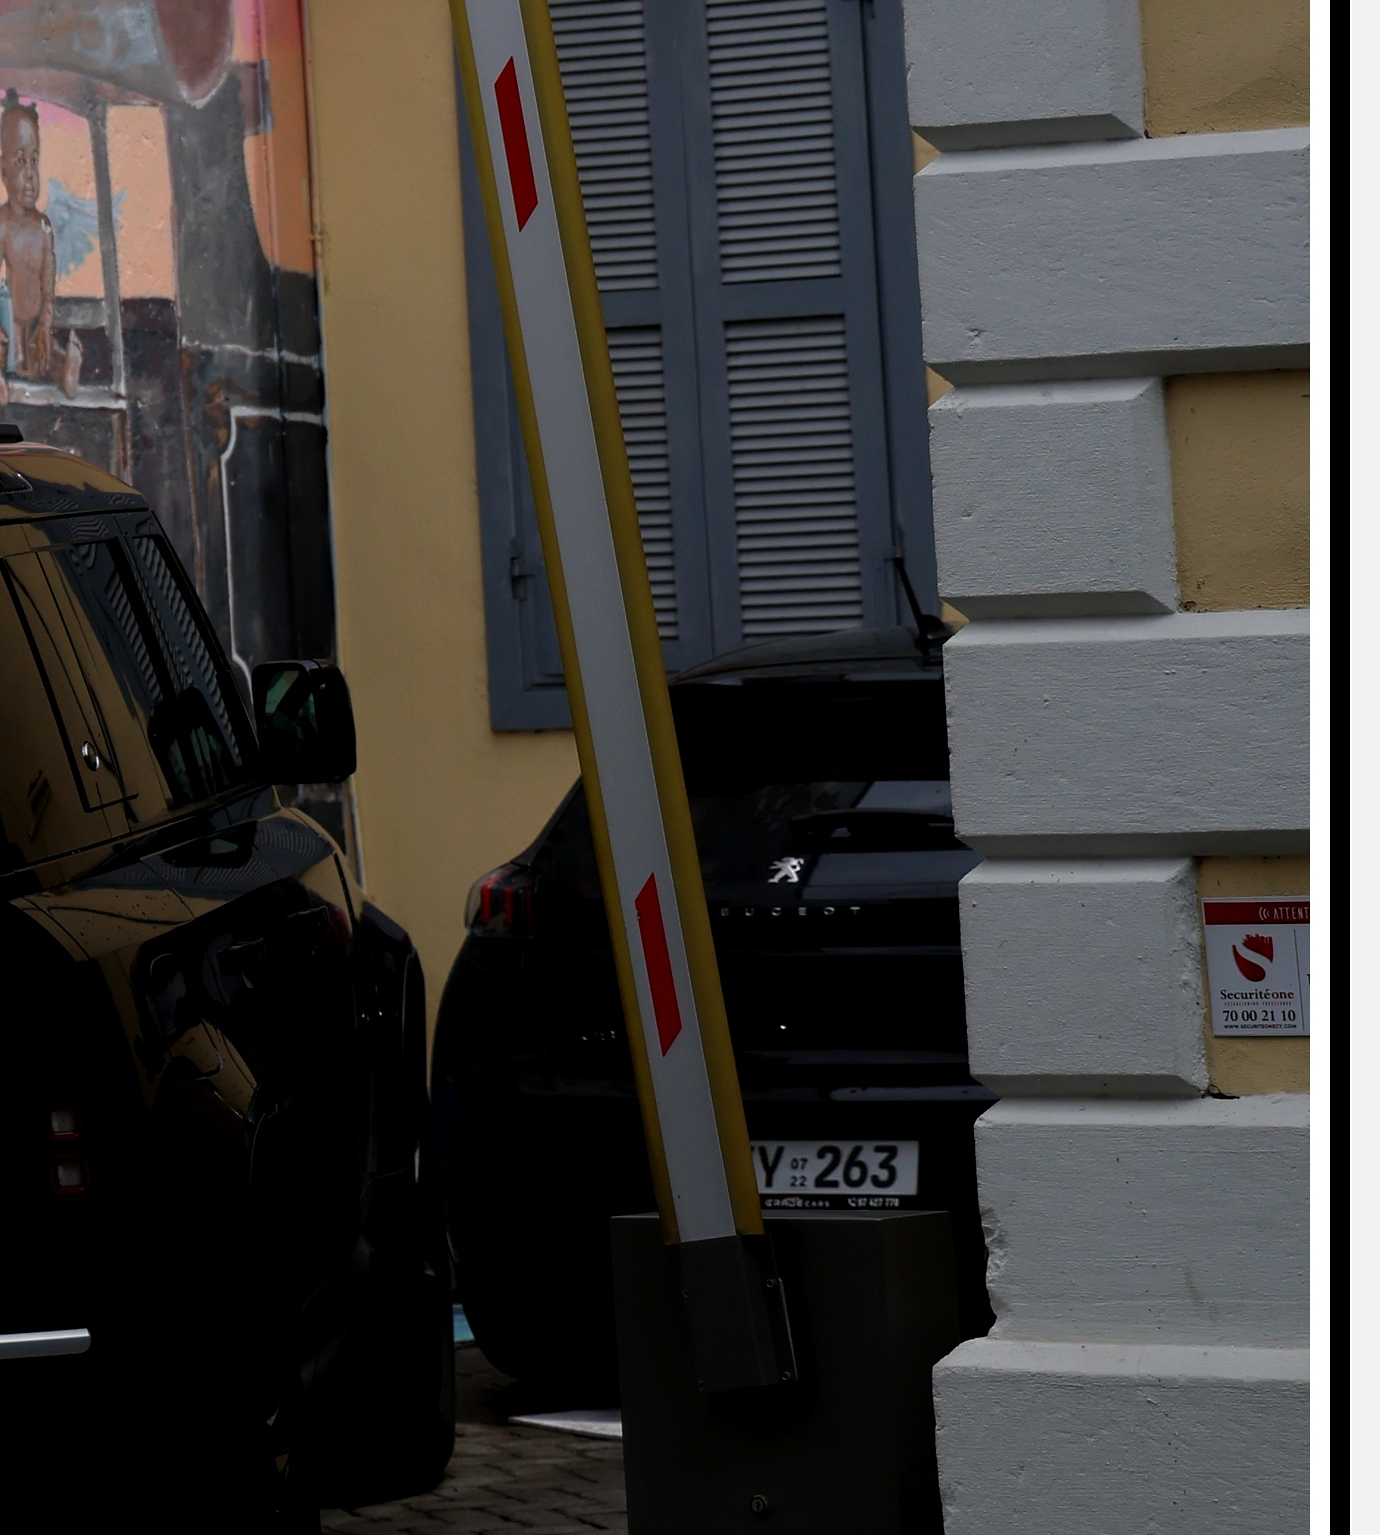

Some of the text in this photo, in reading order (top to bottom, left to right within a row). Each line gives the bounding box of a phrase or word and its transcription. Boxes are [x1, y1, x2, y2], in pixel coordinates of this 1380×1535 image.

[720, 905, 862, 917] EUGEOT
[1222, 1009, 1296, 1022] 70 00 21 10
[751, 1145, 898, 1188] Y 263
[790, 1158, 808, 1170] 07
[790, 1176, 807, 1187] 22
